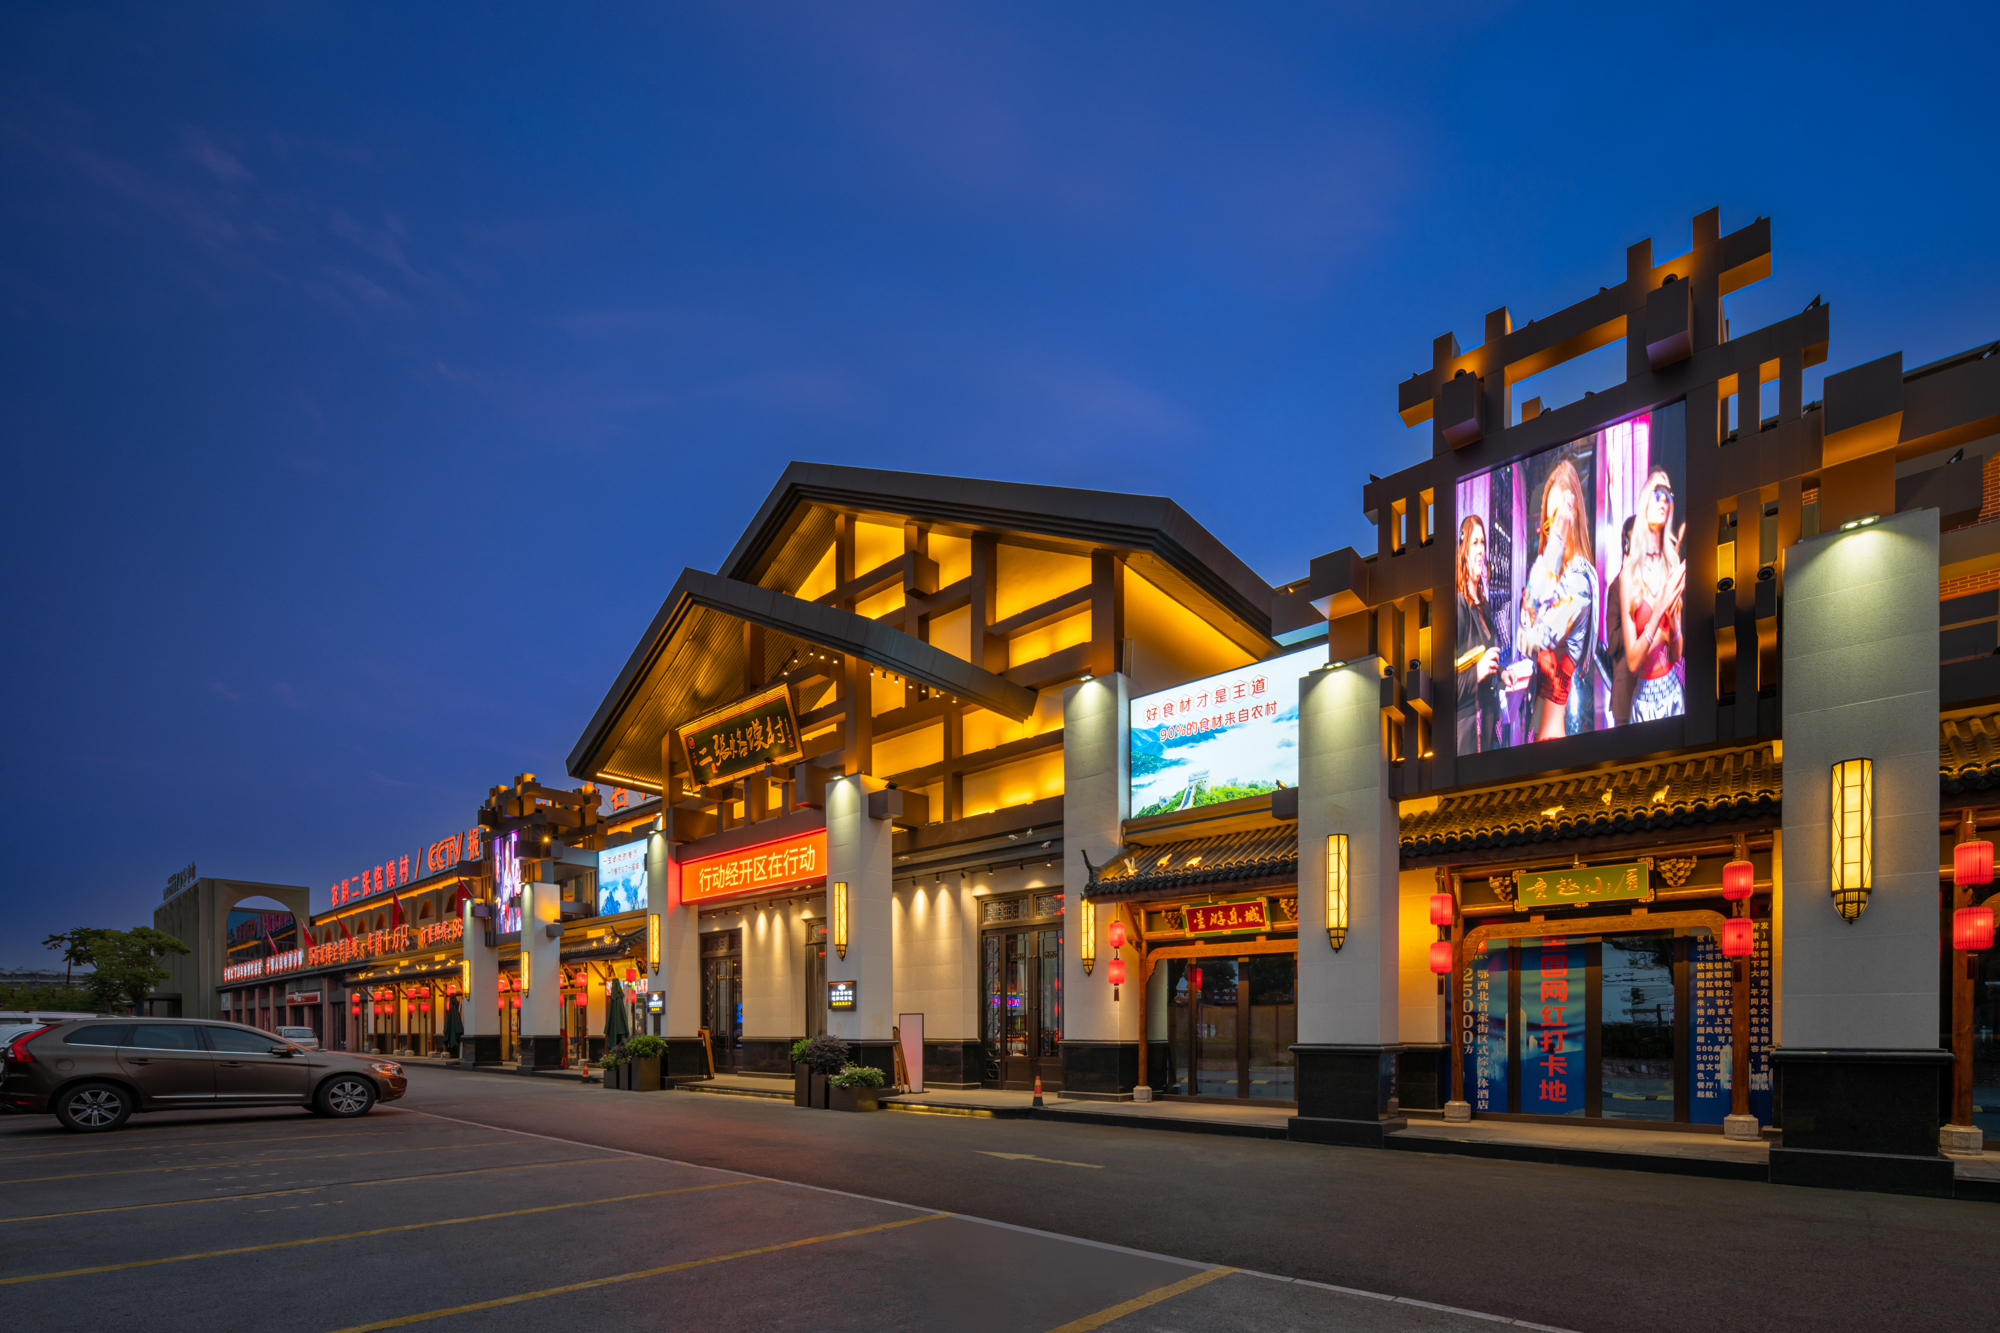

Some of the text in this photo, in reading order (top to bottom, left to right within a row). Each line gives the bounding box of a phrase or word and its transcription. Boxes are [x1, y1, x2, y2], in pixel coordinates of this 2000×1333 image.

[1145, 677, 1266, 723] 好食材才是王道
[1159, 700, 1278, 741] 90%的食材来自农村
[698, 715, 786, 767] 二张烙馍村
[698, 844, 815, 893] 行动经开区在行动
[1526, 868, 1639, 899] 童趣小屋
[1476, 969, 1489, 1110] 鄂西北首家街区式综合体酒店
[1539, 935, 1568, 1102] 全国网红打卡地
